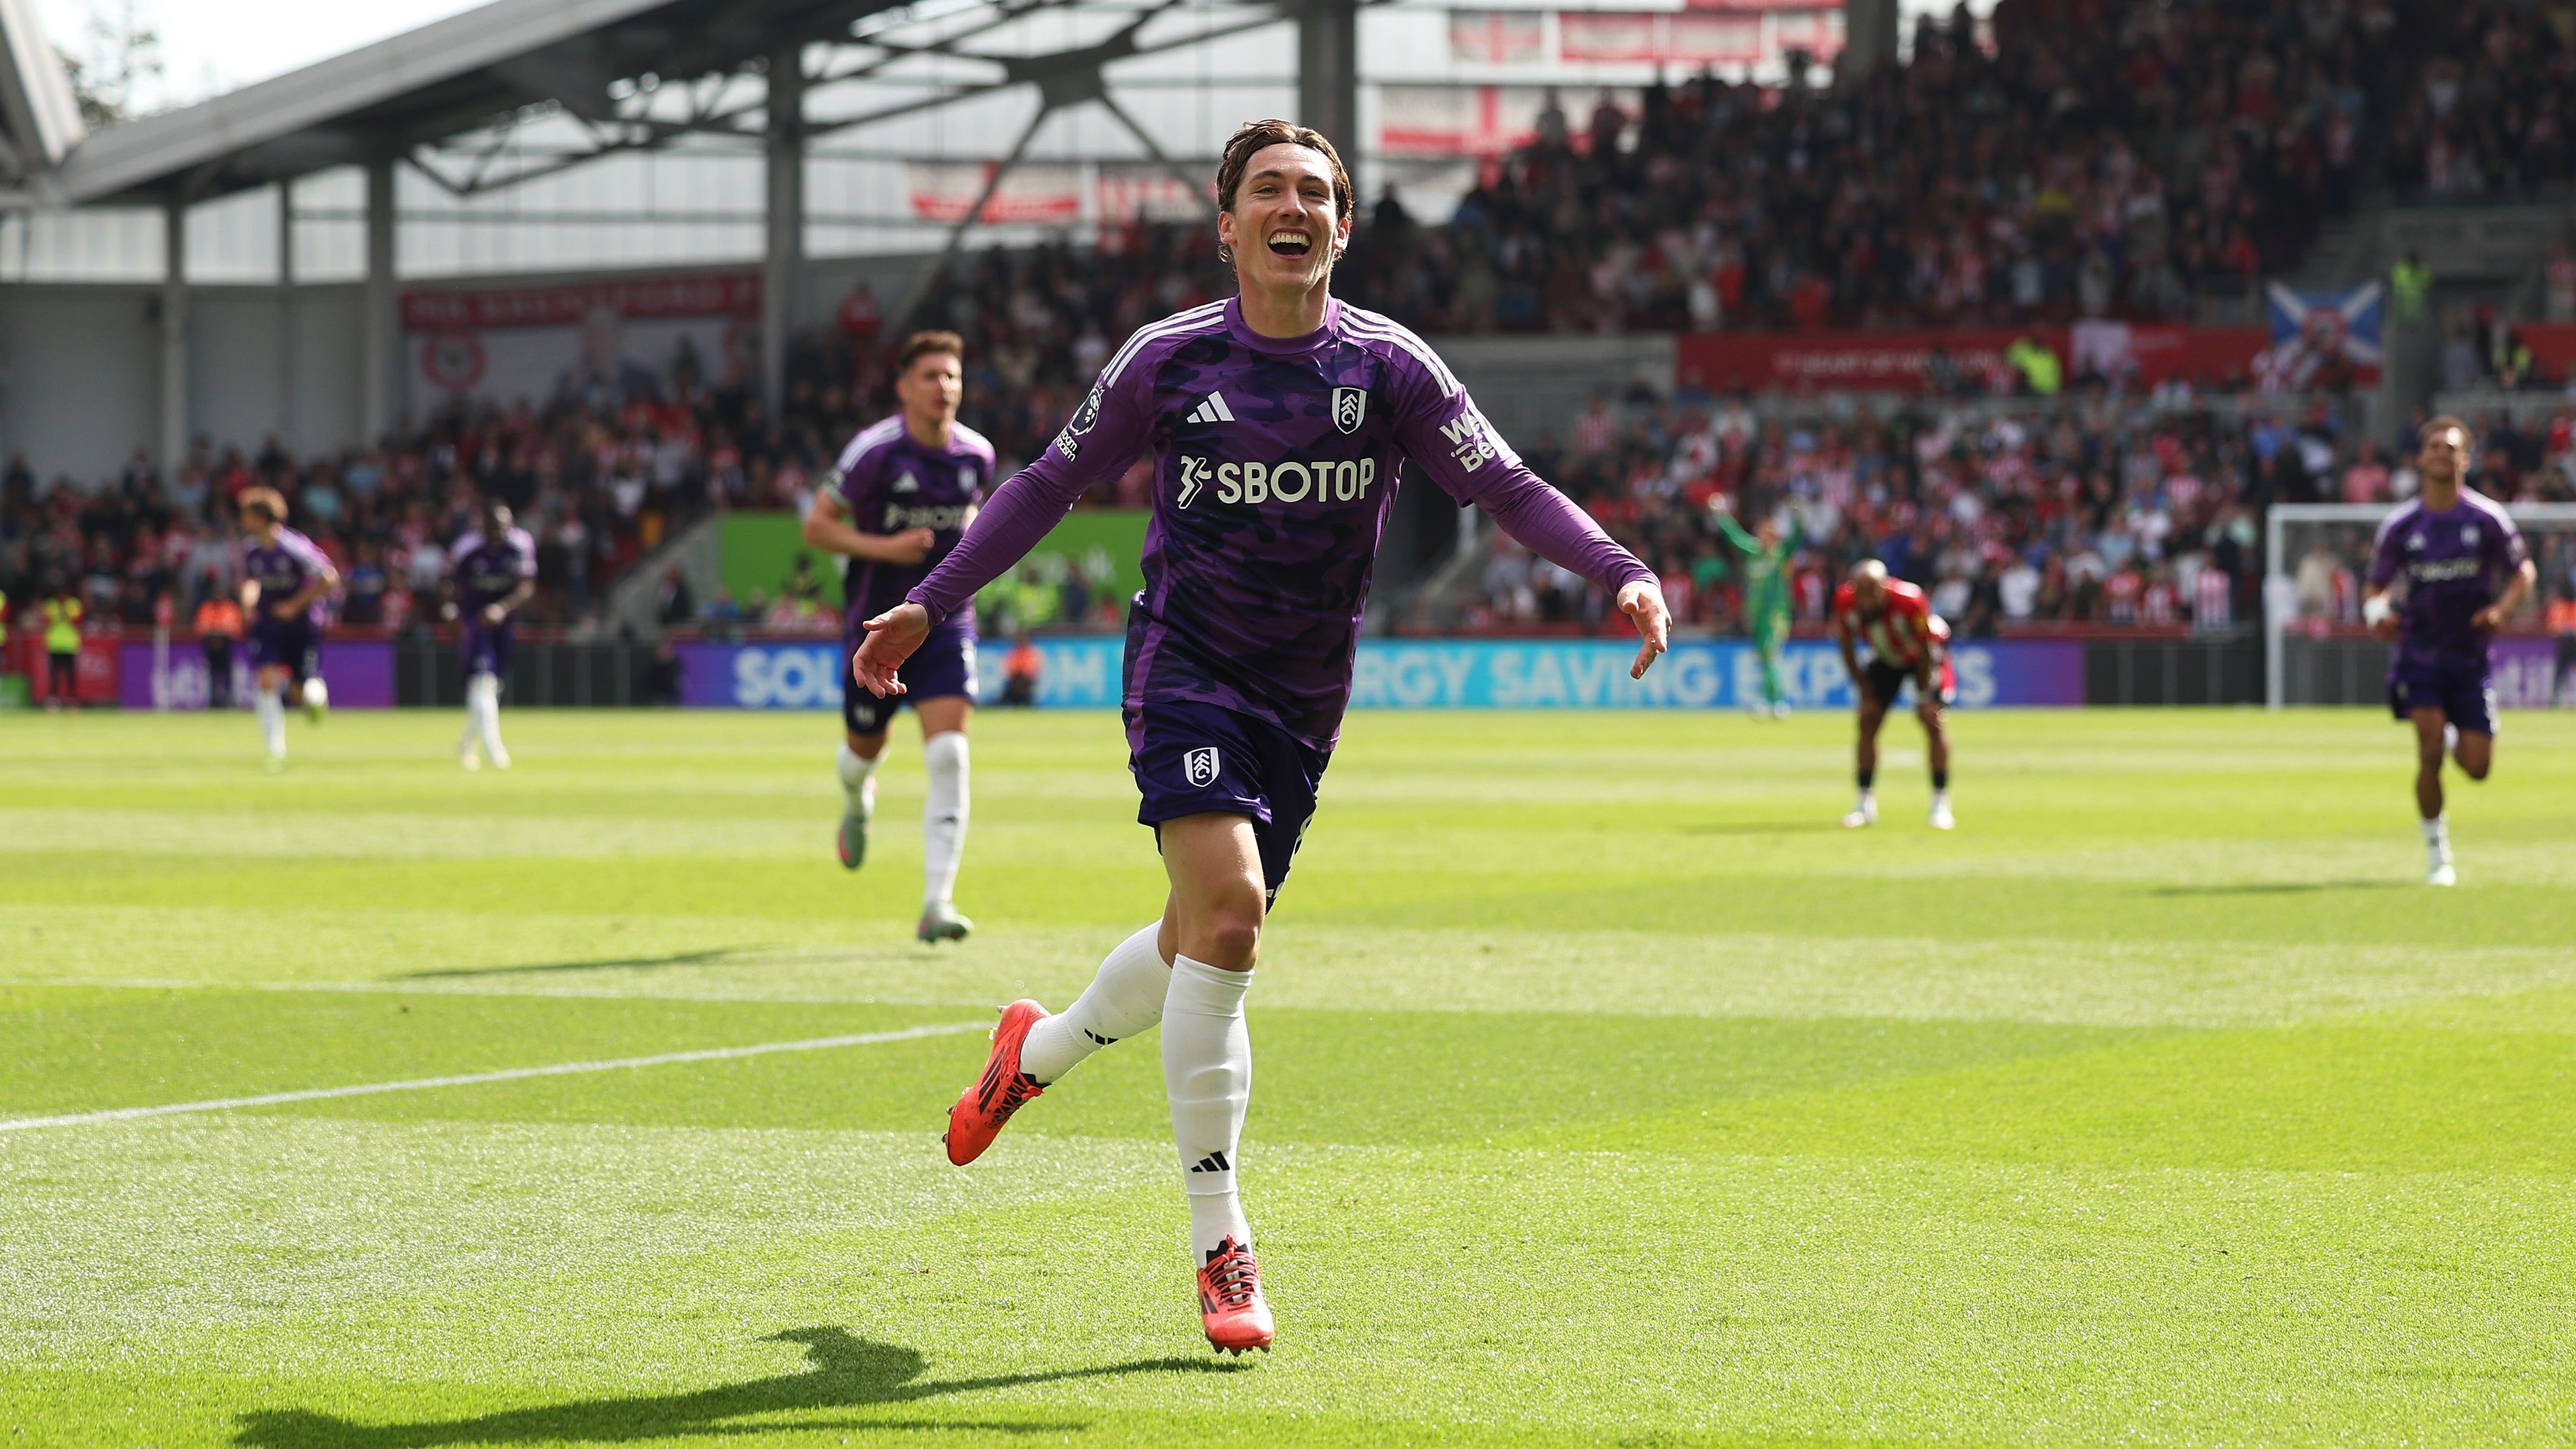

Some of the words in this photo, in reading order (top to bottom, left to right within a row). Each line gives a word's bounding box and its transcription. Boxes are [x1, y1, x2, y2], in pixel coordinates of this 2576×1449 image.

[1217, 457, 1375, 504] SBOTOP
[734, 647, 847, 706] SOL
[1354, 647, 1473, 705] RGY
[1490, 647, 1719, 706] SAVING
